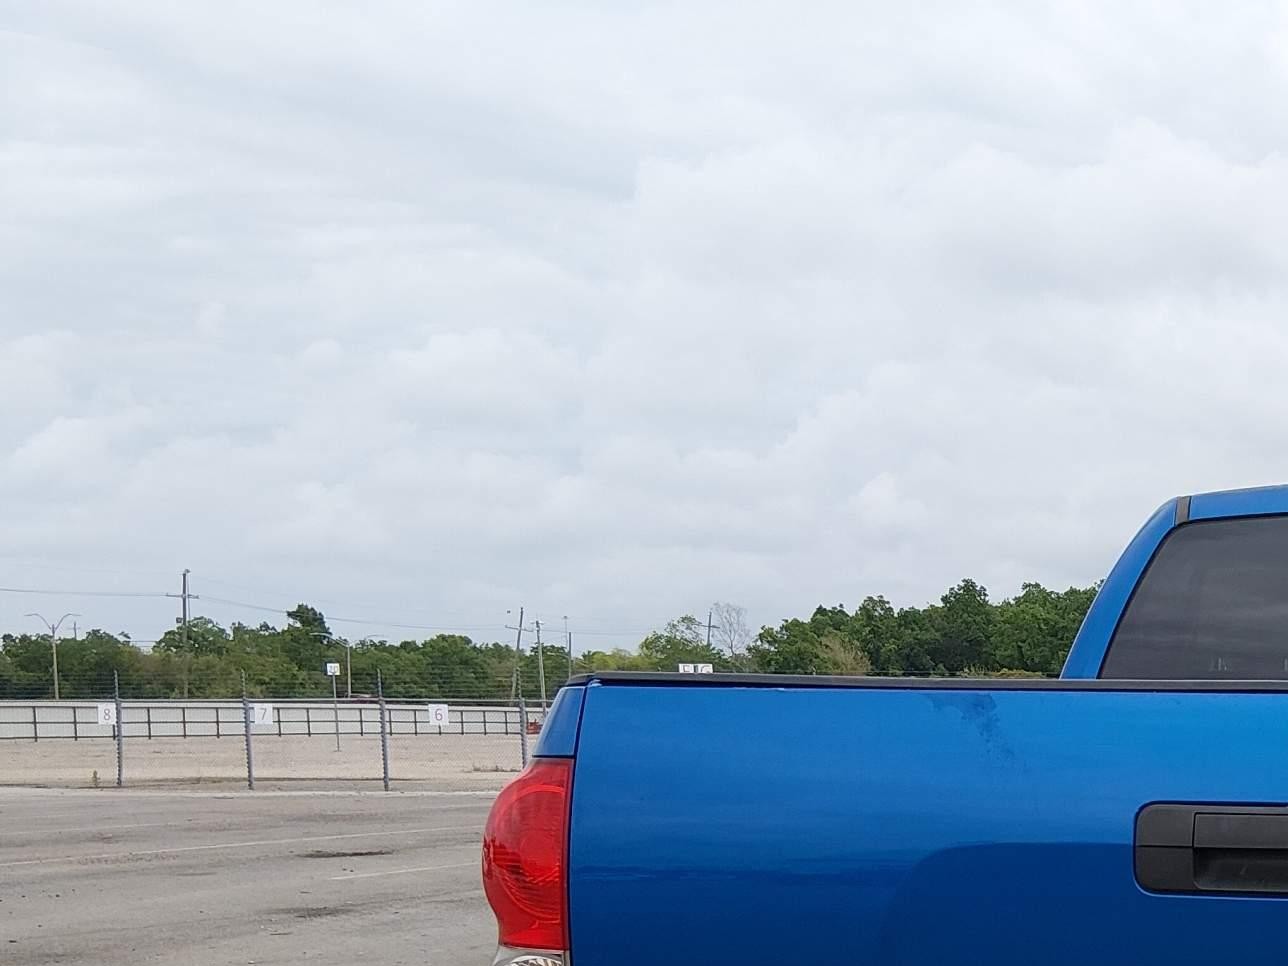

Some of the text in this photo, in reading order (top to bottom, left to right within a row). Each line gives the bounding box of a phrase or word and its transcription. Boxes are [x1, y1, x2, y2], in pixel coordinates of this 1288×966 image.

[103, 708, 111, 721] 8
[259, 707, 267, 721] 7
[434, 708, 443, 721] 6
